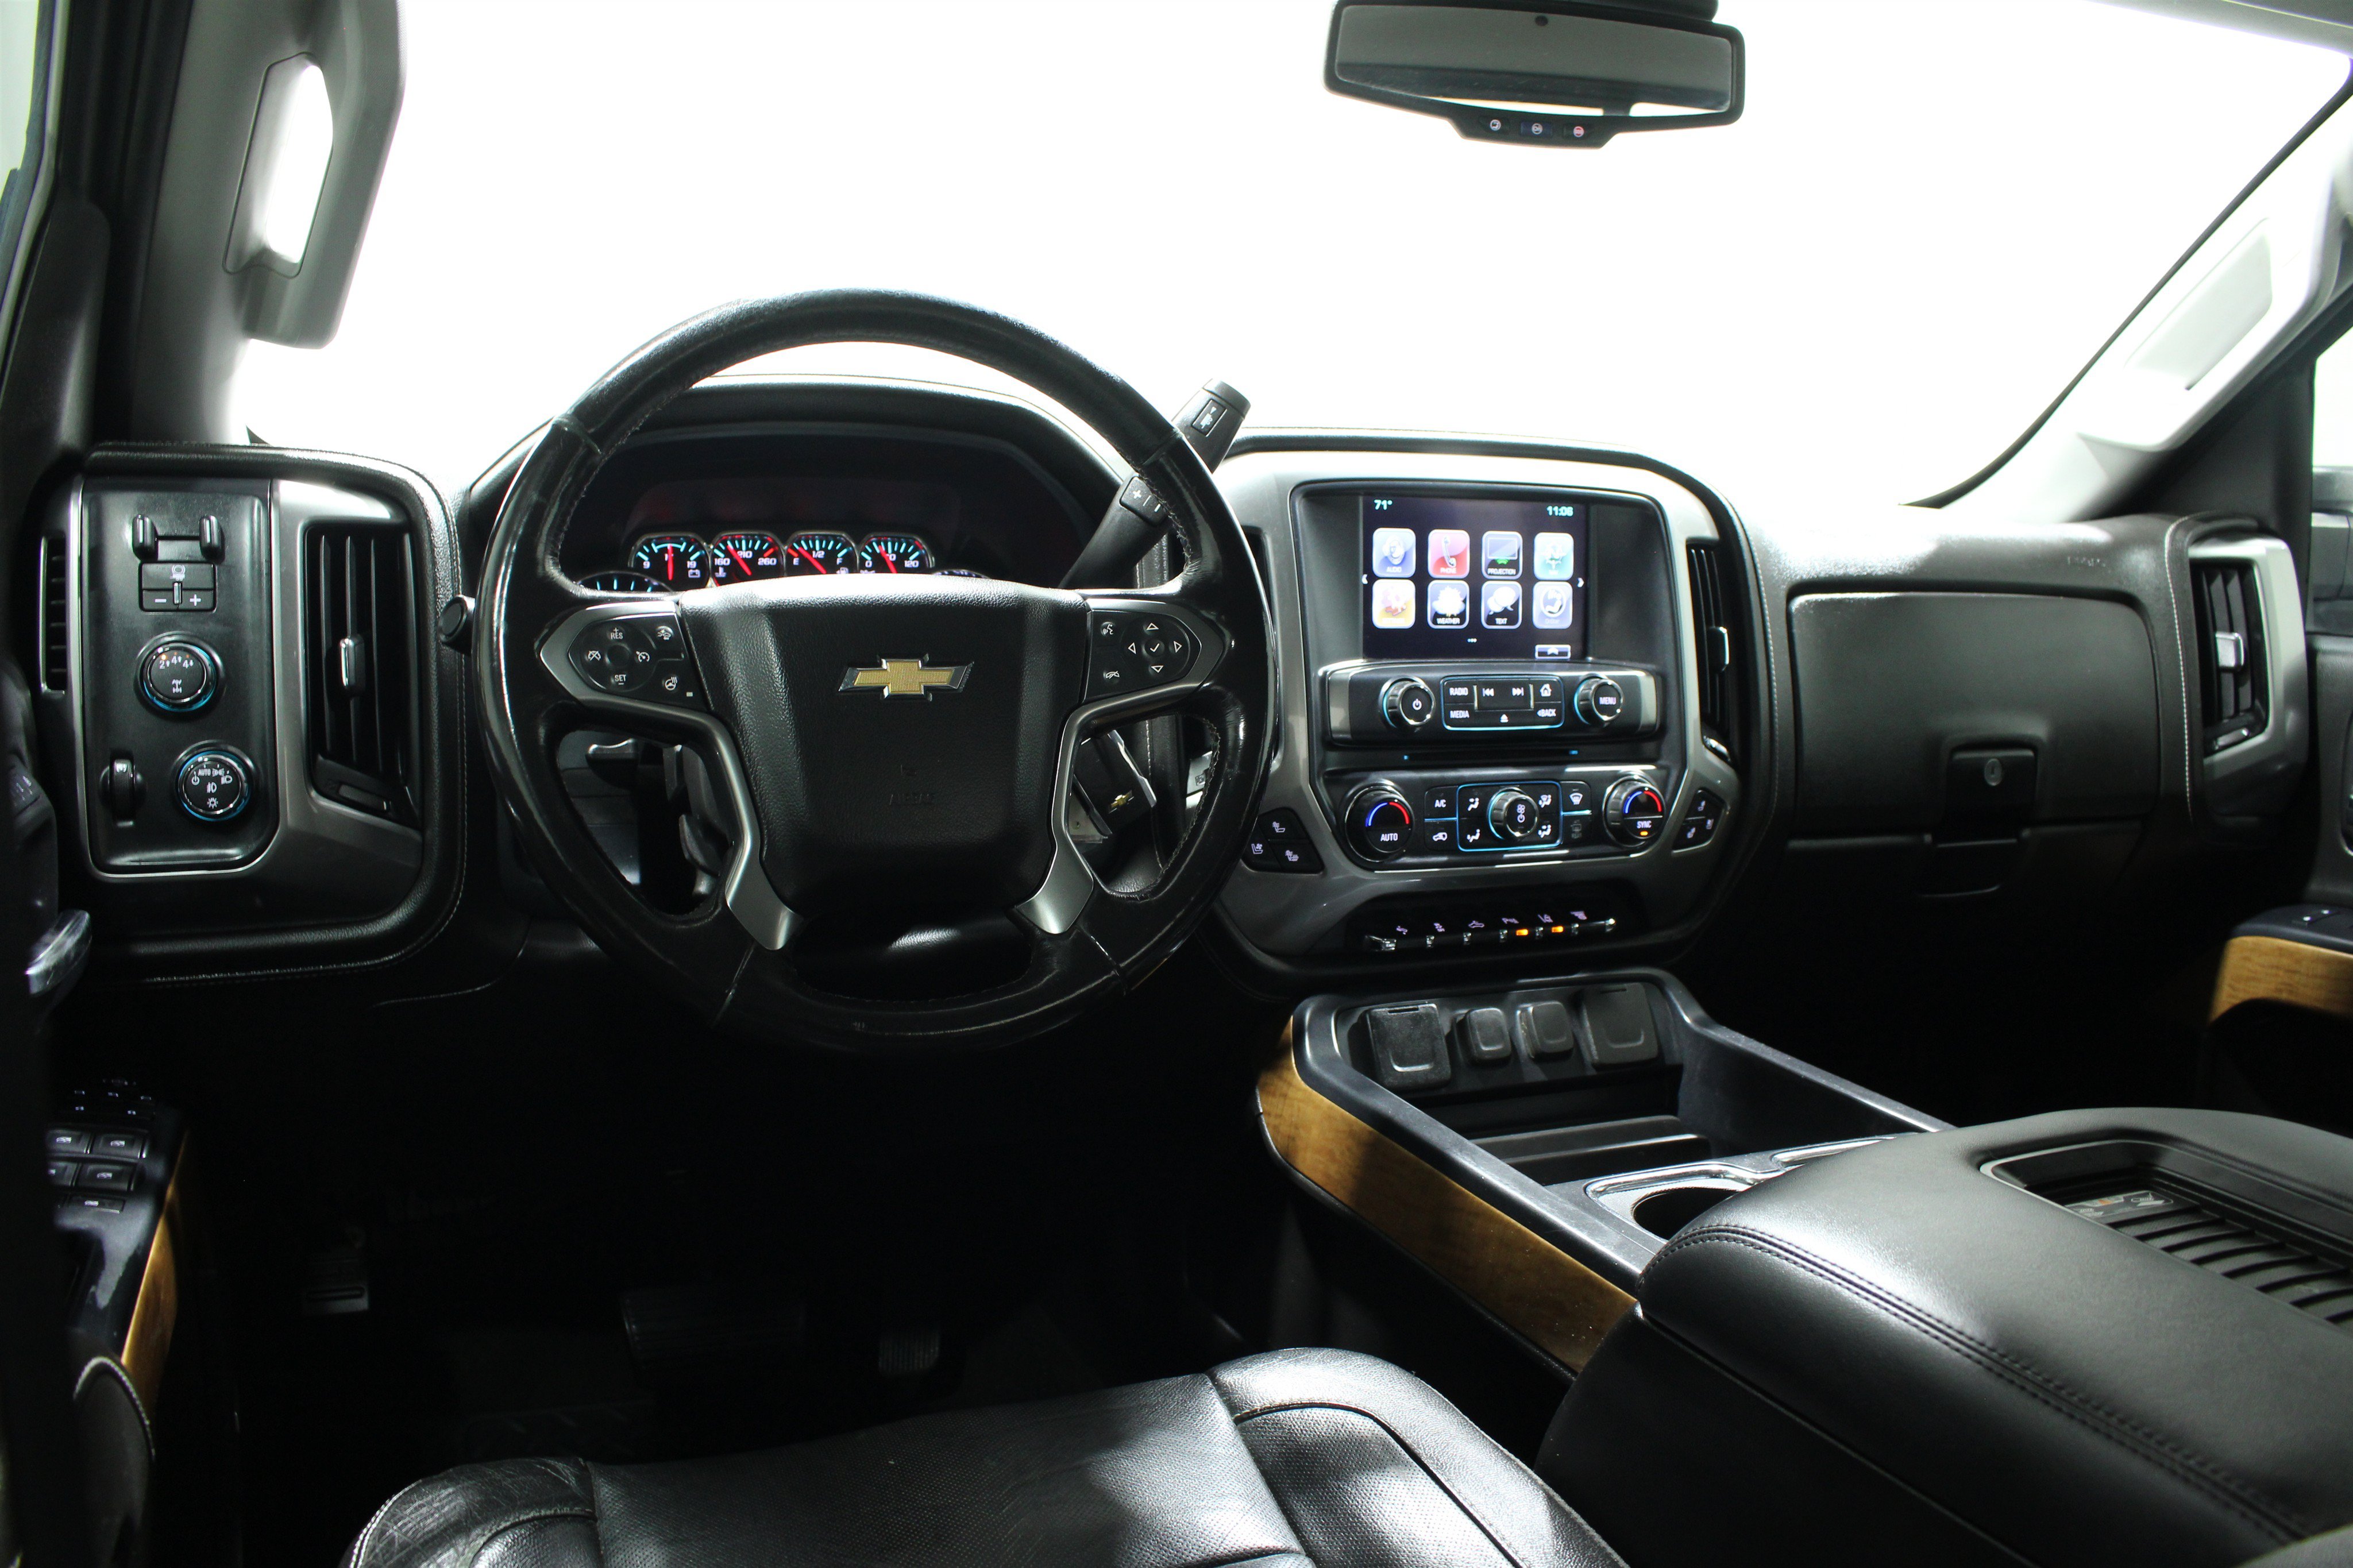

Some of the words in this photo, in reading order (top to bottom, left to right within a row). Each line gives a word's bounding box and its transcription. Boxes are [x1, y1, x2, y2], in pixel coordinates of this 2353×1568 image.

[715, 558, 730, 566] 160
[758, 558, 777, 566] 260
[1449, 687, 1468, 696] RADIO
[1599, 697, 1617, 705] MENU
[1449, 710, 1469, 719] MEDIA
[1541, 709, 1556, 717] BACK
[1434, 799, 1446, 808] A/C
[1637, 820, 1652, 828] SYNC
[1380, 833, 1398, 841] AUTO
